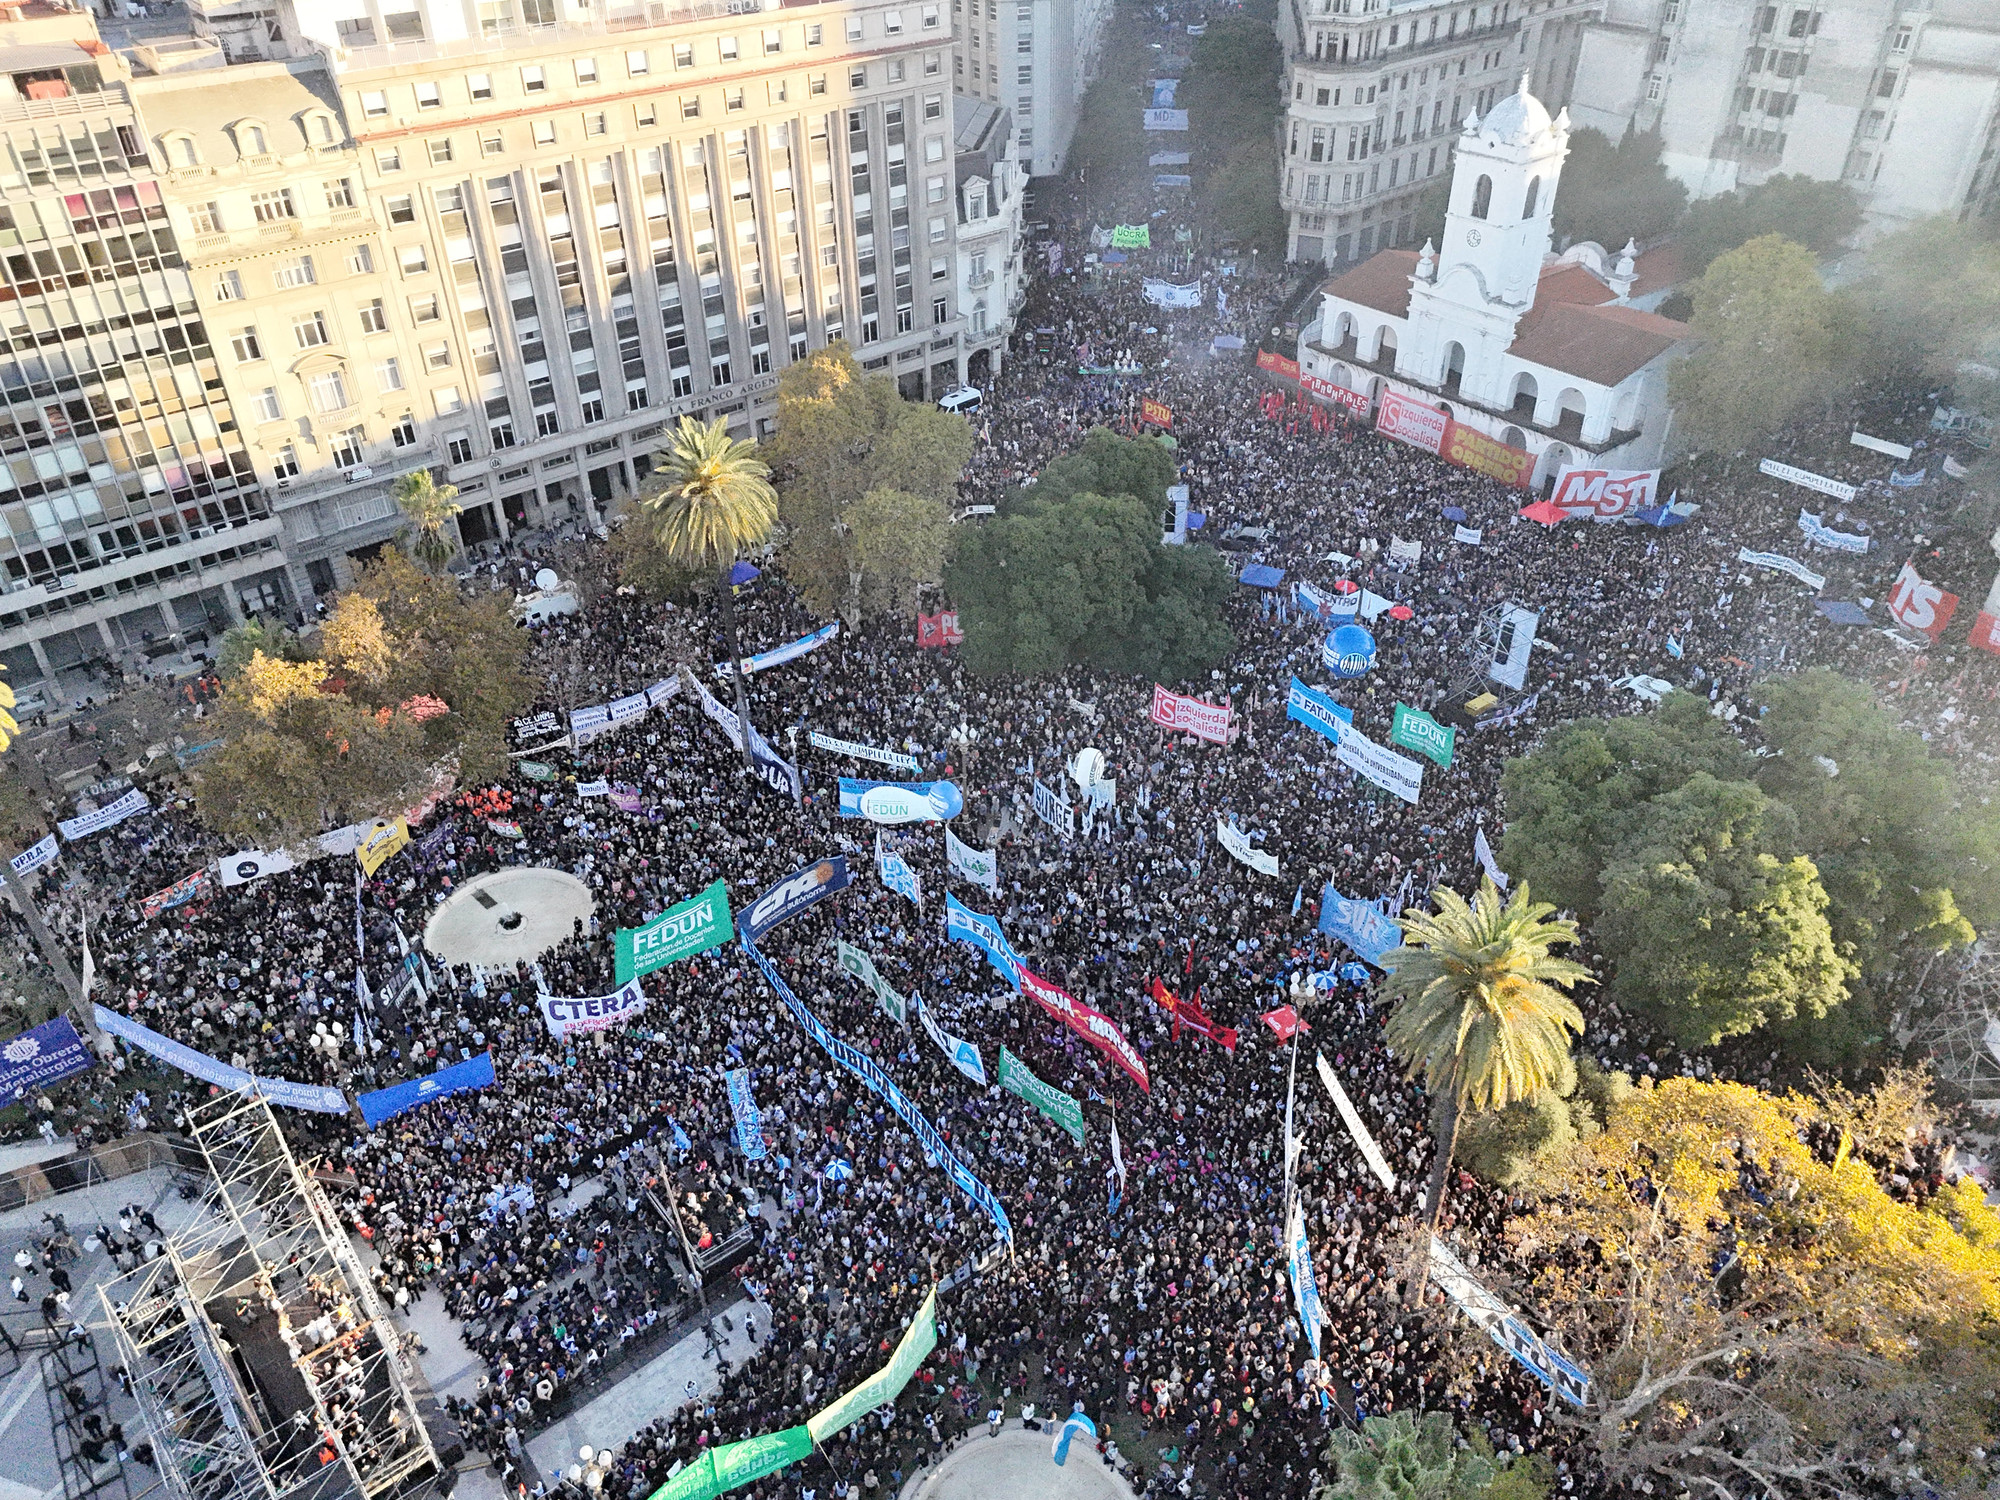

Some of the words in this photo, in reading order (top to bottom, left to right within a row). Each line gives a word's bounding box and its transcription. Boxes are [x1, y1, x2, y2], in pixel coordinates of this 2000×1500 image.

[1117, 226, 1146, 239] UOCRA
[669, 406, 684, 415] LA
[690, 390, 734, 408] FRANCO
[740, 376, 781, 394] ARGENT
[1145, 401, 1170, 422] PSTU
[1311, 378, 1368, 411] IRROMPIBLES
[1400, 404, 1443, 432] izquierda
[1396, 422, 1439, 449] socialista
[1453, 428, 1527, 470] PARTIDO
[1451, 445, 1519, 484] OBRERO
[1176, 702, 1226, 724] izquierda
[1176, 714, 1225, 736] socialista
[1303, 698, 1336, 727] FATUN
[1402, 713, 1447, 749] FEDUN
[895, 753, 911, 765] LEY
[79, 776, 134, 799] KOLINA
[1035, 785, 1072, 834] SURGE
[786, 884, 827, 910] autónoma
[633, 902, 714, 954] FEDUN
[633, 943, 673, 963] Federación
[672, 938, 683, 948] de
[683, 925, 716, 944] Docentes
[633, 961, 644, 971] de
[644, 956, 656, 967] las
[656, 937, 705, 961] Universidades
[548, 986, 638, 1021] CTERA
[564, 1022, 576, 1030] EN
[576, 1016, 610, 1027] DEFENSA
[0, 1065, 30, 1082] nión
[32, 1041, 82, 1069] Obrera
[0, 1054, 85, 1096] Metalúrgica
[824, 1034, 892, 1099] PUBLICA
[900, 1096, 960, 1180] SIEMPRE
